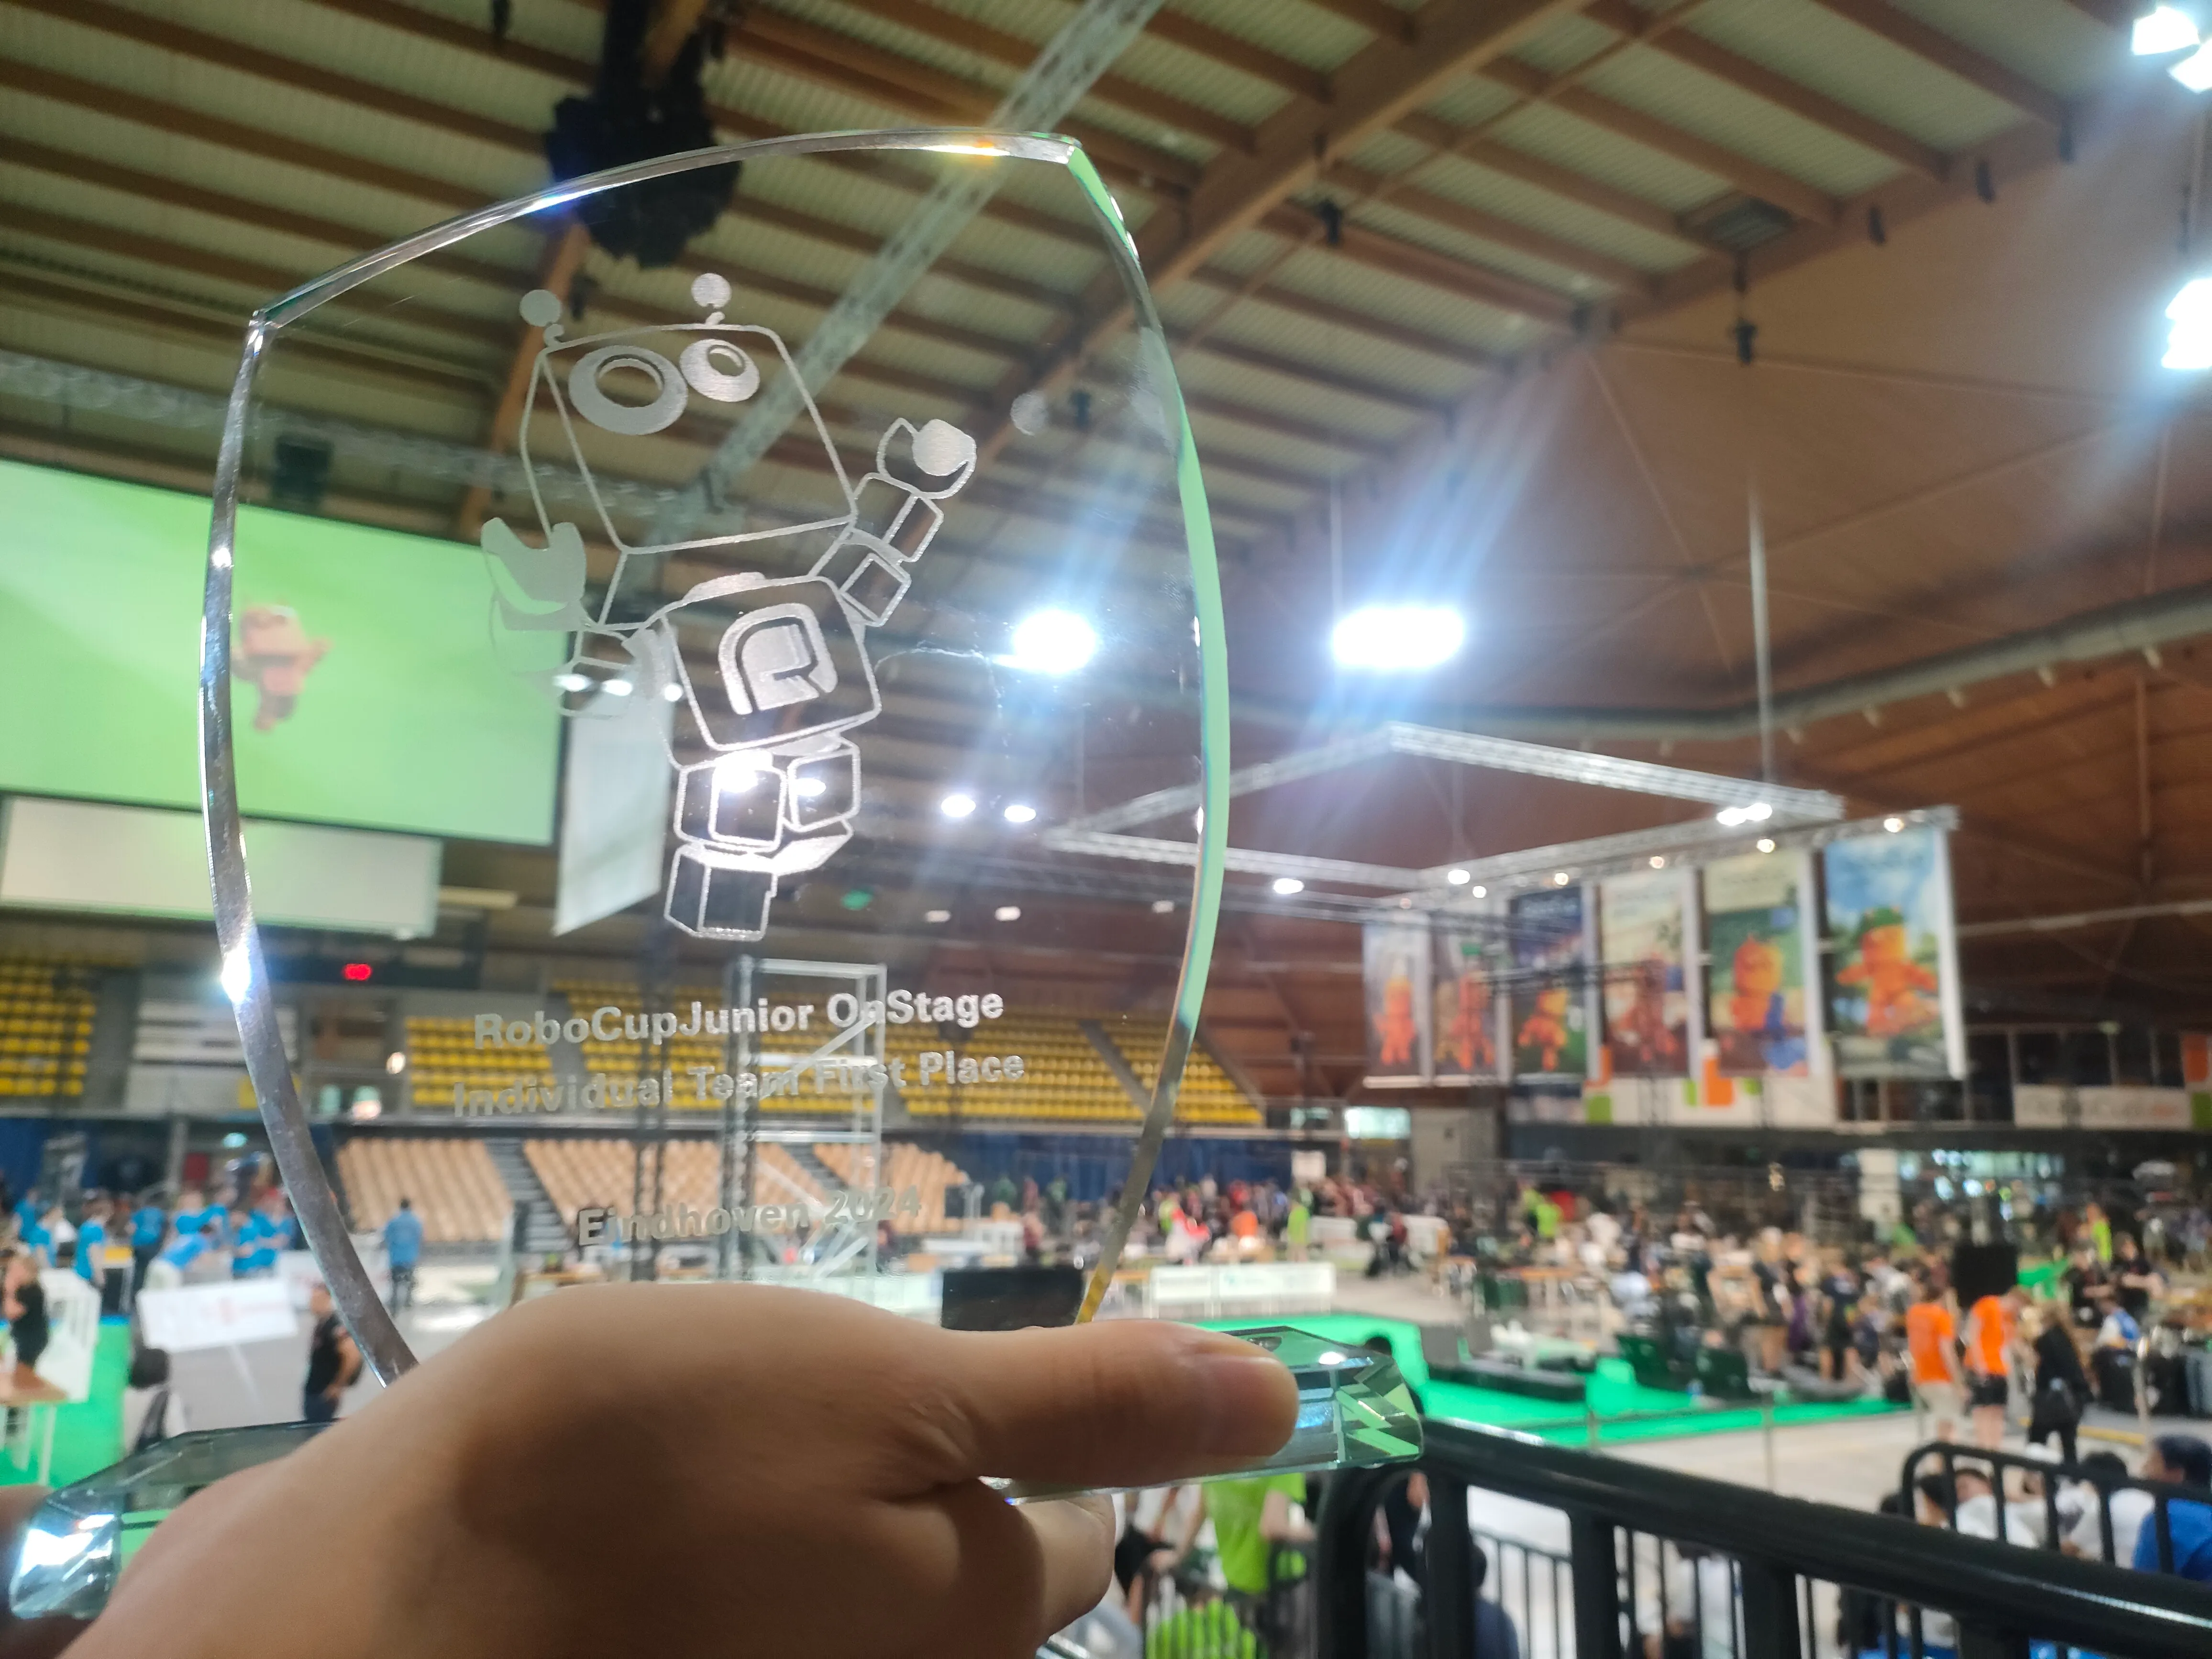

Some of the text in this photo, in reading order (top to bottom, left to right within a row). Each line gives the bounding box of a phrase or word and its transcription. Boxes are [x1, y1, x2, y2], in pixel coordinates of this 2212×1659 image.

[475, 989, 1004, 1050] RoboCupJunior OnStage
[453, 1051, 1025, 1117] Individual Team First Place
[578, 1185, 922, 1246] Eindhoven 2024
